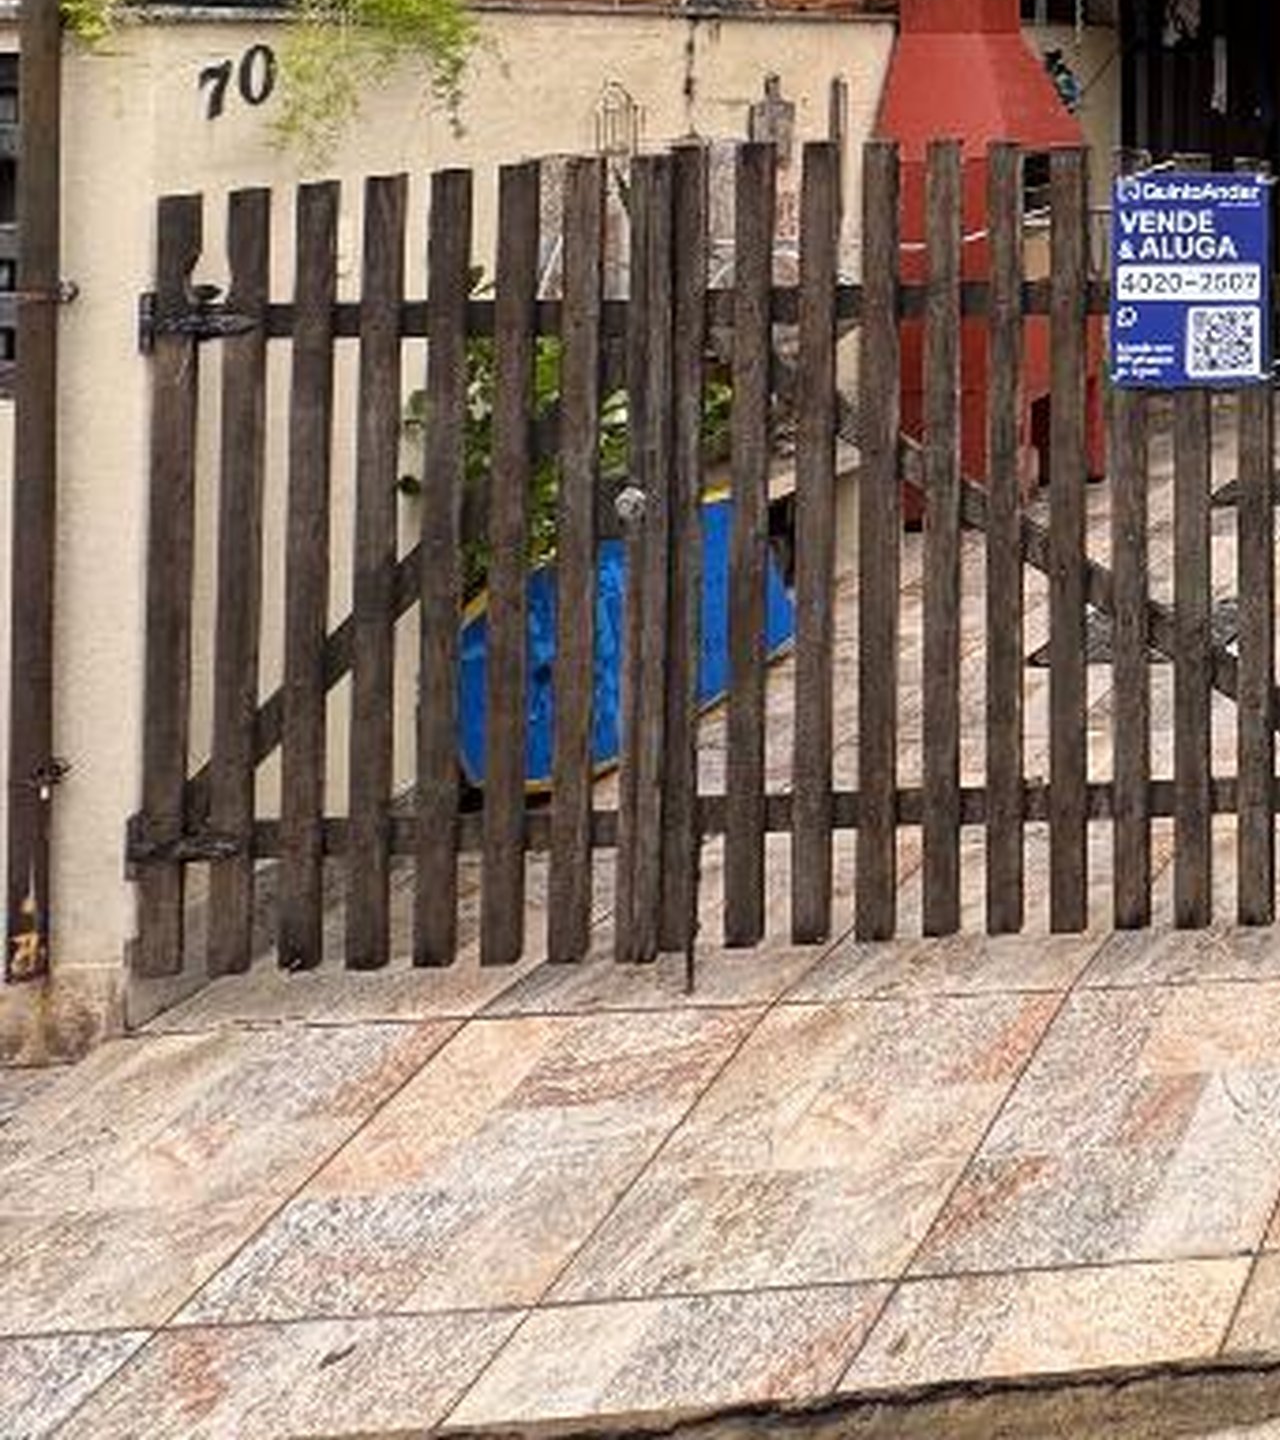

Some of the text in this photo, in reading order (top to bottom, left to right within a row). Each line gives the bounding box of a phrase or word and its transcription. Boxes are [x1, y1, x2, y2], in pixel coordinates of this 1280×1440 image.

[198, 44, 278, 121] 70
[1120, 211, 1215, 234] VENDE
[1118, 236, 1238, 260] & ALUGA
